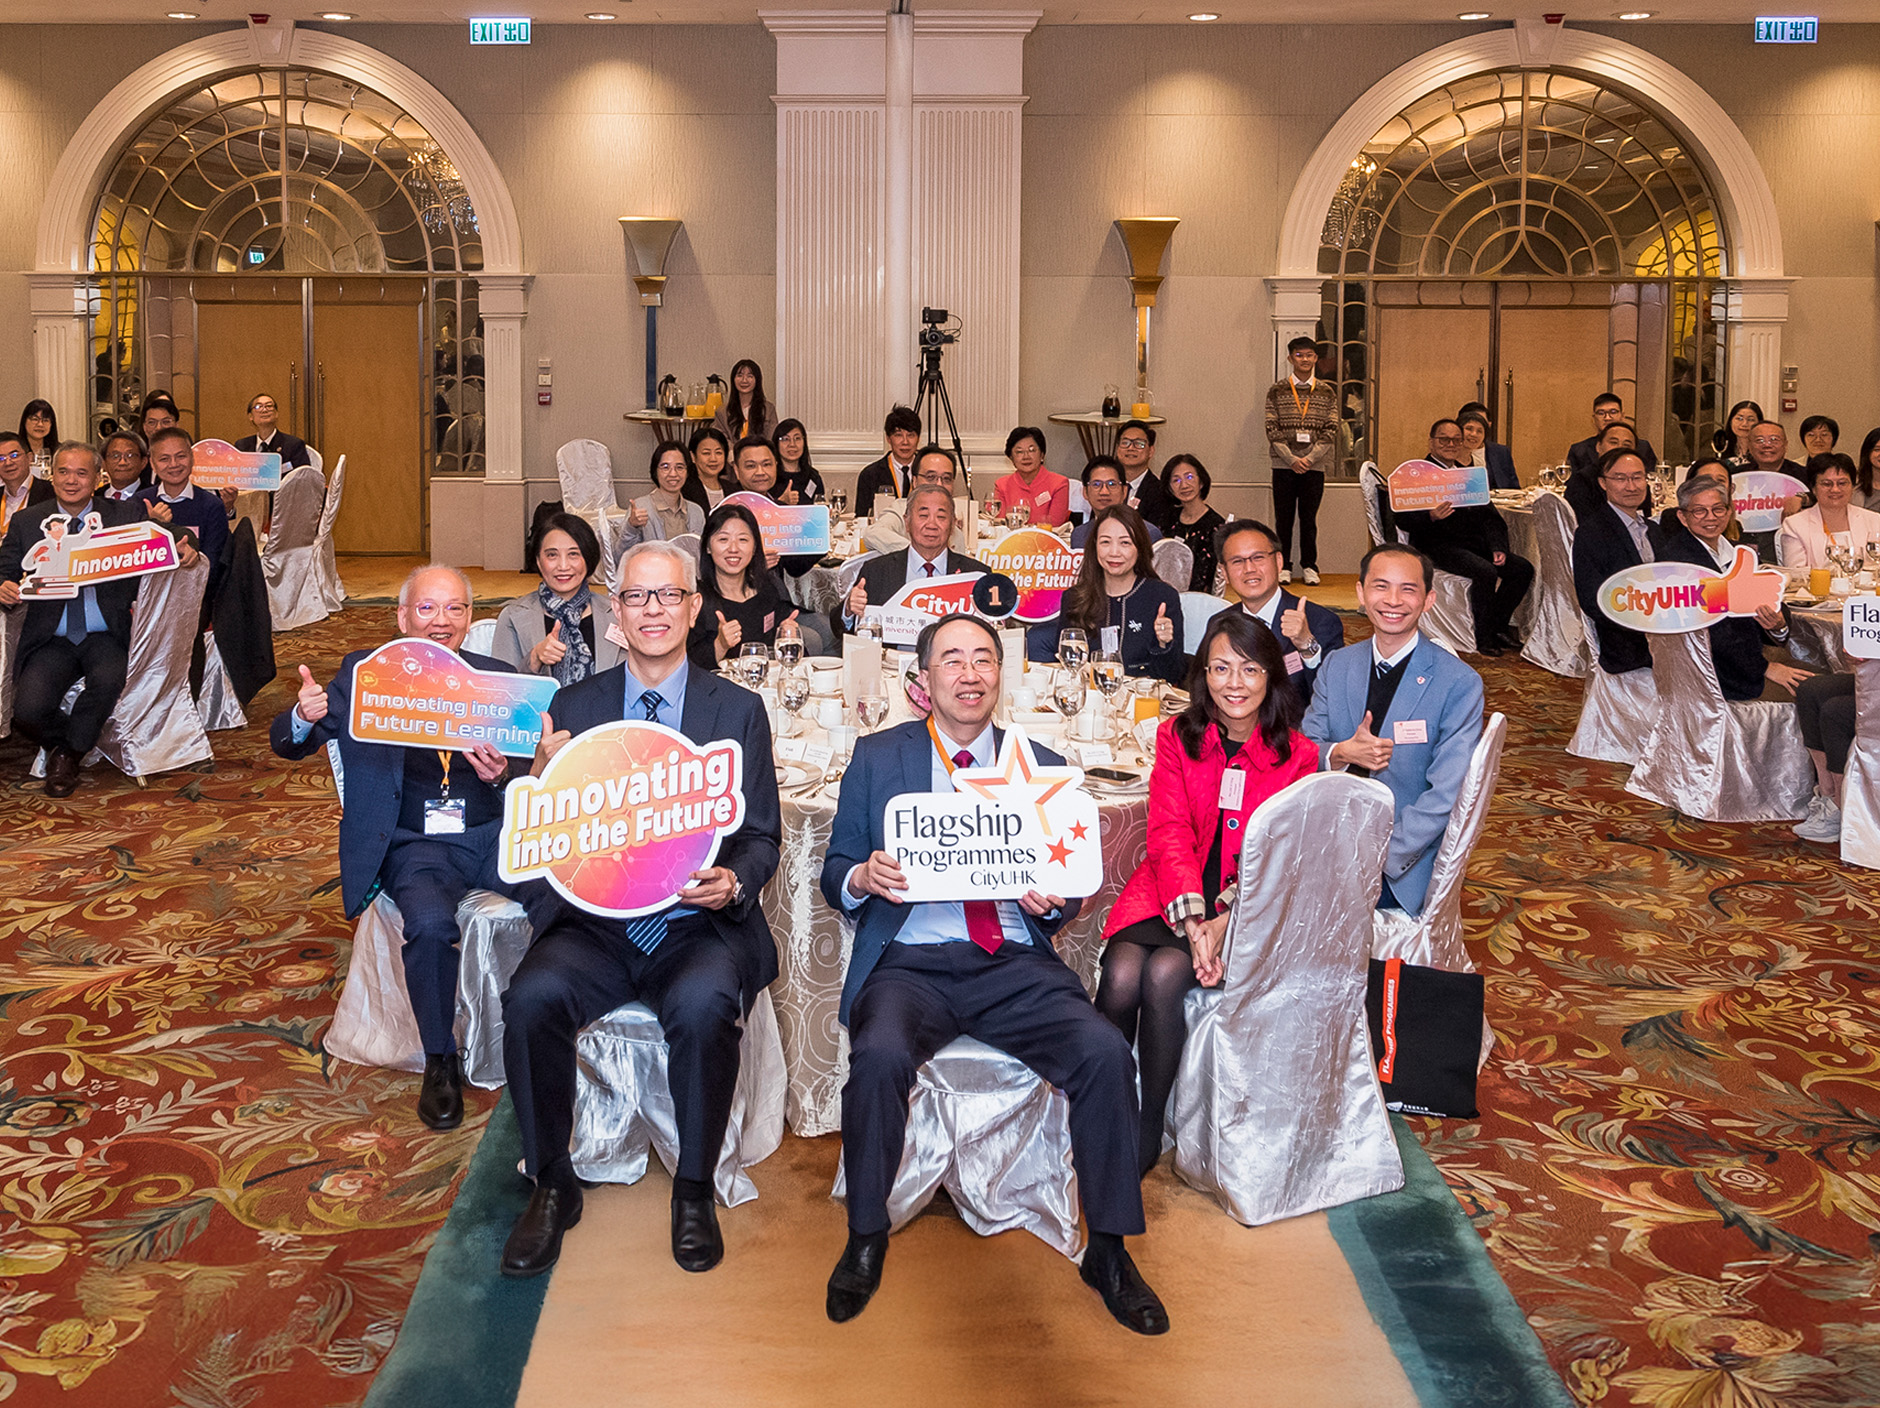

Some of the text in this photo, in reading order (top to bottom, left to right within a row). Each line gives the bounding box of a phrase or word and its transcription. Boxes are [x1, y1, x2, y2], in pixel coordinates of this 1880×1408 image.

[472, 22, 529, 42] EXIT 出口
[1756, 21, 1815, 40] EXIT 出口
[193, 465, 238, 475] nnovating
[227, 475, 277, 486] Learning
[1394, 482, 1466, 496] Innovating into
[1395, 496, 1434, 507] Future
[1733, 492, 1785, 514] spiratio
[779, 524, 802, 534] into
[764, 536, 823, 548] Learning
[71, 544, 168, 576] Innovative
[982, 548, 1084, 576] Innovating
[1035, 572, 1079, 588] Futur
[988, 585, 1002, 606] 1
[1610, 585, 1707, 616] CityUHK
[885, 626, 919, 636] niversity
[361, 691, 511, 718] Innovating into
[360, 711, 542, 747] Future Learning
[517, 750, 730, 831] Innovating
[512, 796, 733, 870] into the Future
[895, 803, 1022, 847] Flagship
[896, 847, 1037, 873] Programmes
[970, 869, 1037, 890] CityUHK
